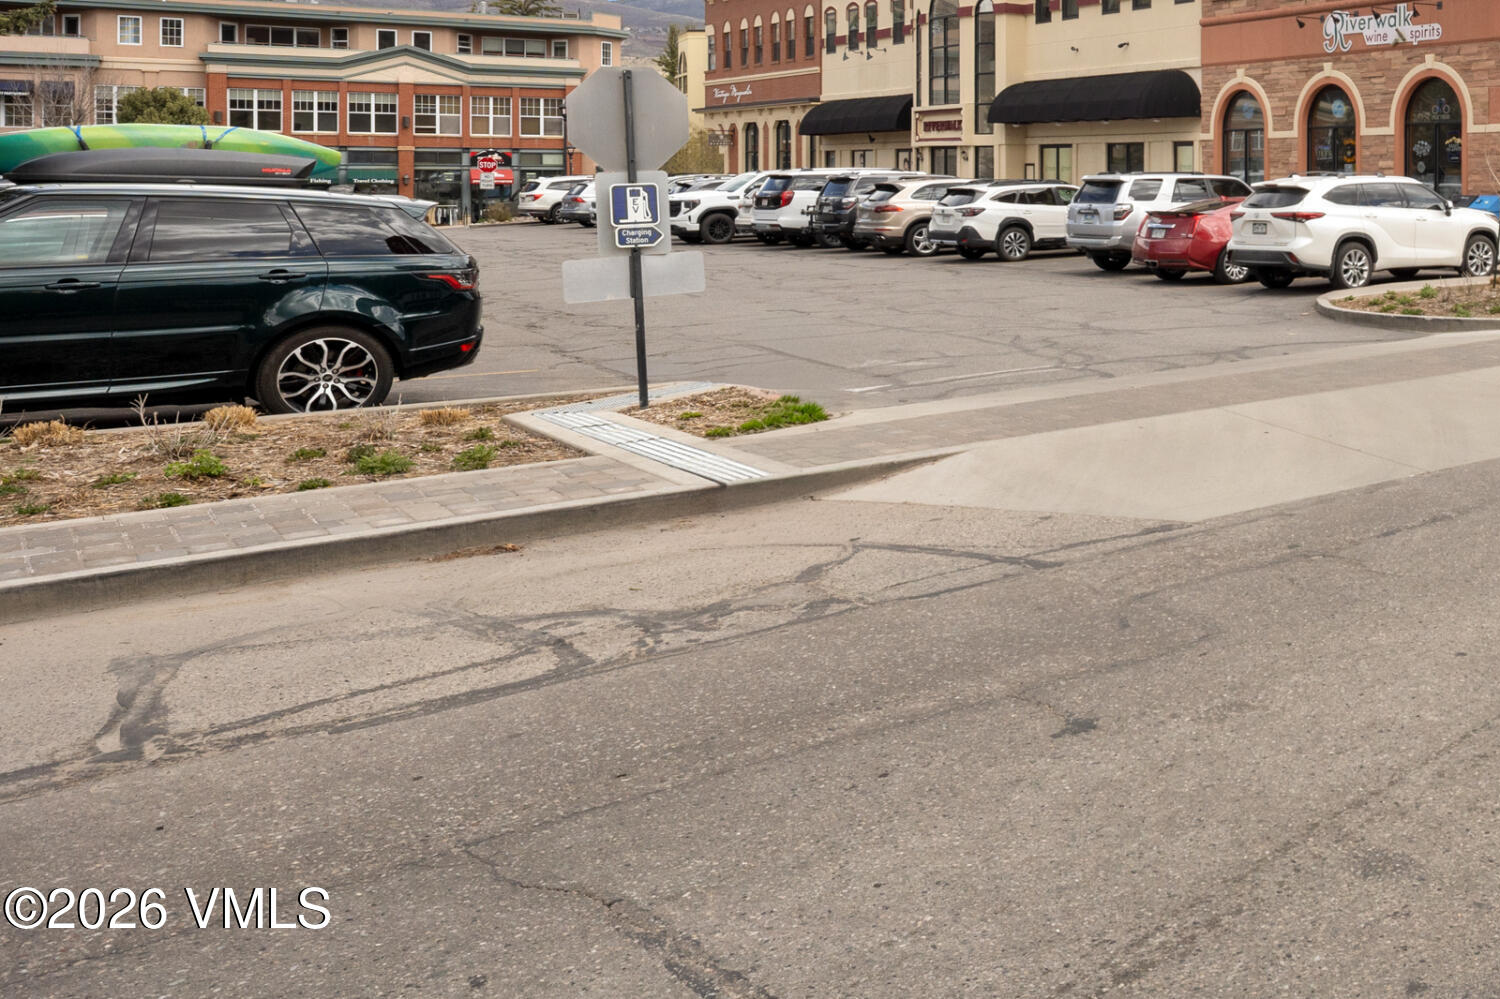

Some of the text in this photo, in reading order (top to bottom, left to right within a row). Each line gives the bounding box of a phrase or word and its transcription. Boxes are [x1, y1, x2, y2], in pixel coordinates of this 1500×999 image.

[1324, 4, 1411, 52] Riverwalk
[1365, 24, 1441, 43] wine spirits
[479, 161, 496, 169] STOP
[632, 198, 640, 213] EV
[622, 230, 652, 238] Charging
